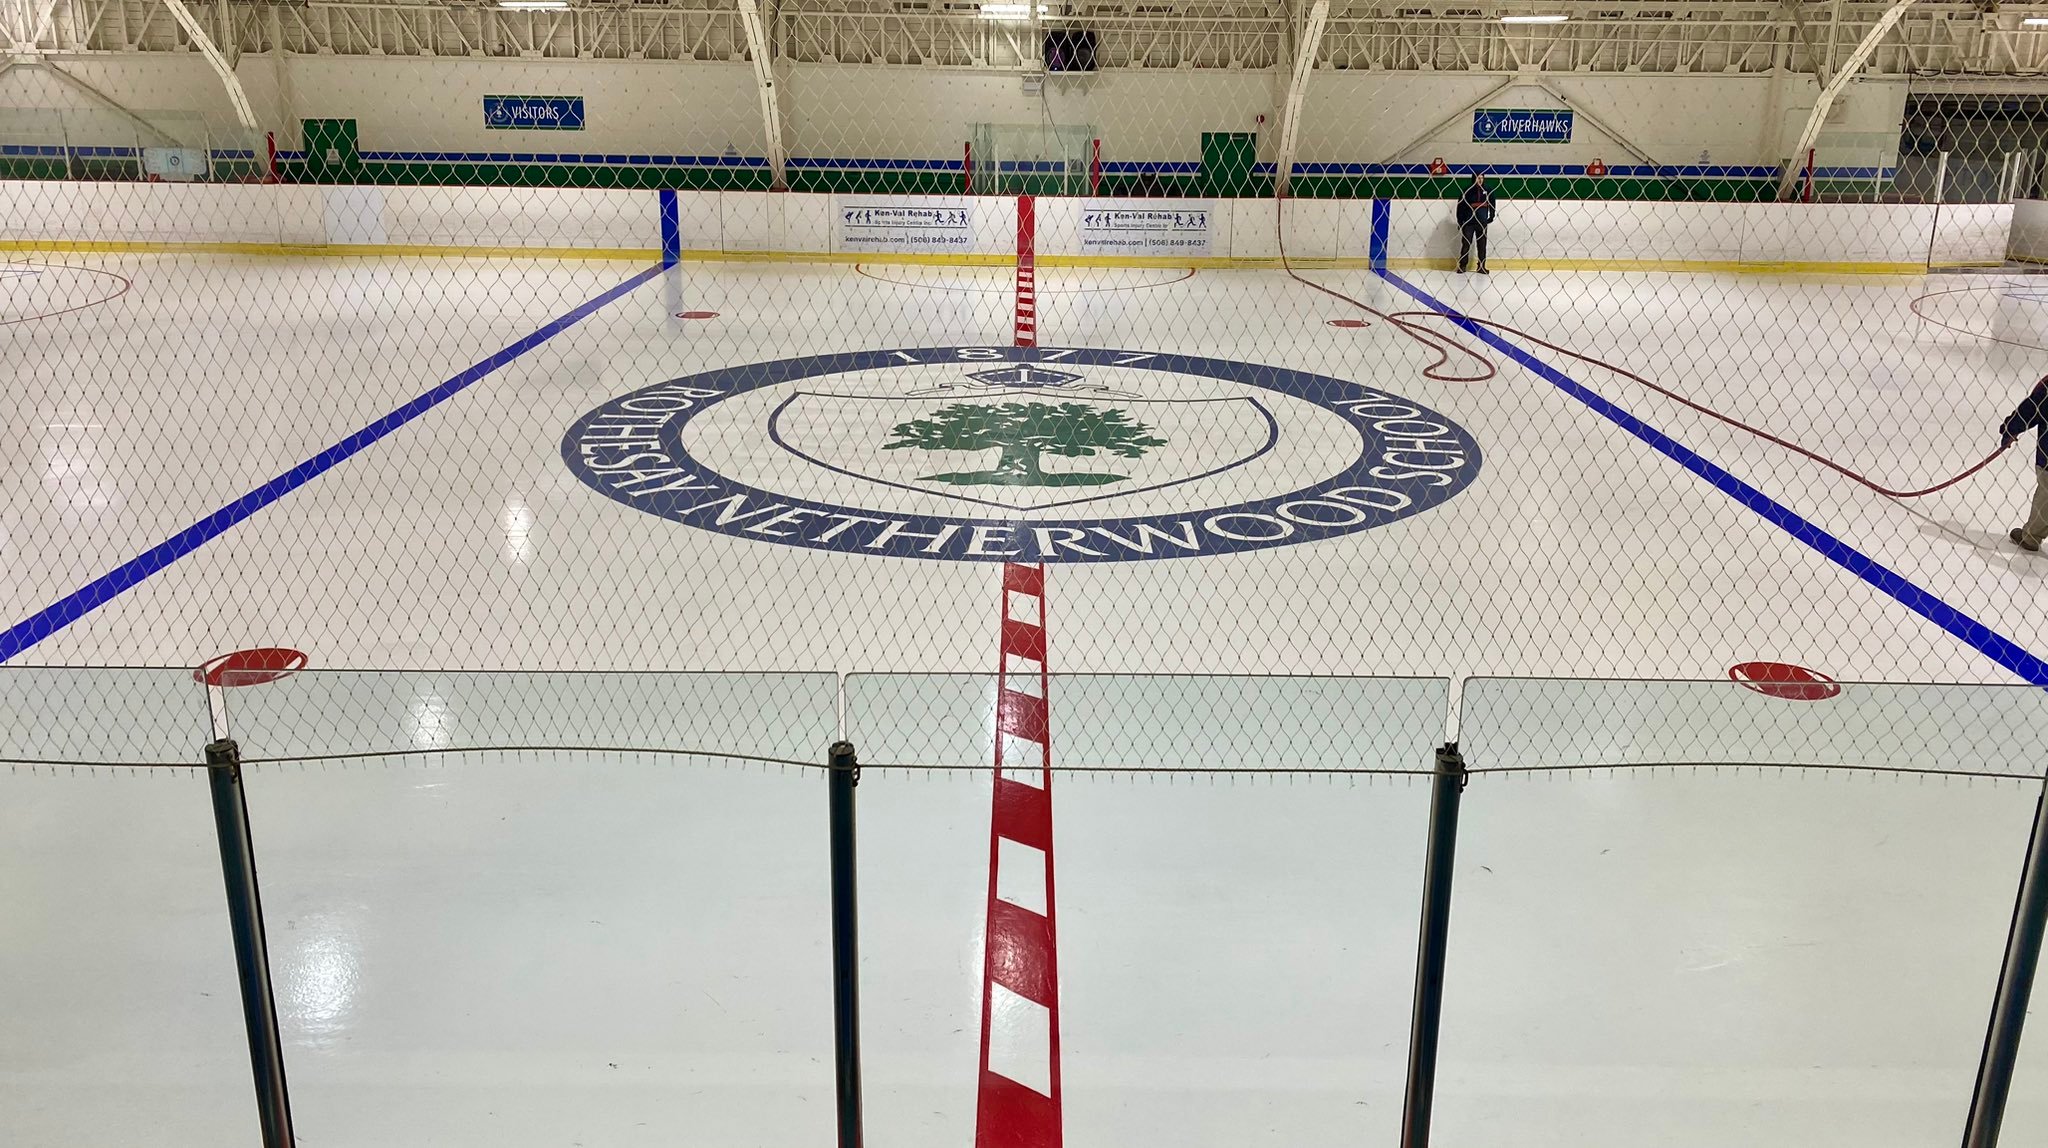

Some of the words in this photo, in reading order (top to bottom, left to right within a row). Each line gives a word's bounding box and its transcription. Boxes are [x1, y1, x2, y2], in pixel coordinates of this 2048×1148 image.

[511, 106, 560, 120] VISITORS
[1501, 119, 1569, 133] RIVERHAWKS
[874, 209, 905, 217] Ken-Val
[907, 210, 933, 218] Rehab
[1114, 212, 1145, 220] Ken-Val
[845, 235, 905, 243] kenvalrehab.com
[931, 236, 968, 244] 849-8437
[1084, 239, 1144, 247] kenvalrehab.com
[1169, 239, 1206, 247] 849-8437
[888, 347, 1157, 364] 1877
[580, 384, 727, 498] ROTHESAY
[675, 485, 1413, 558] NETHERWOOD
[1331, 391, 1466, 487] SCHOOL
